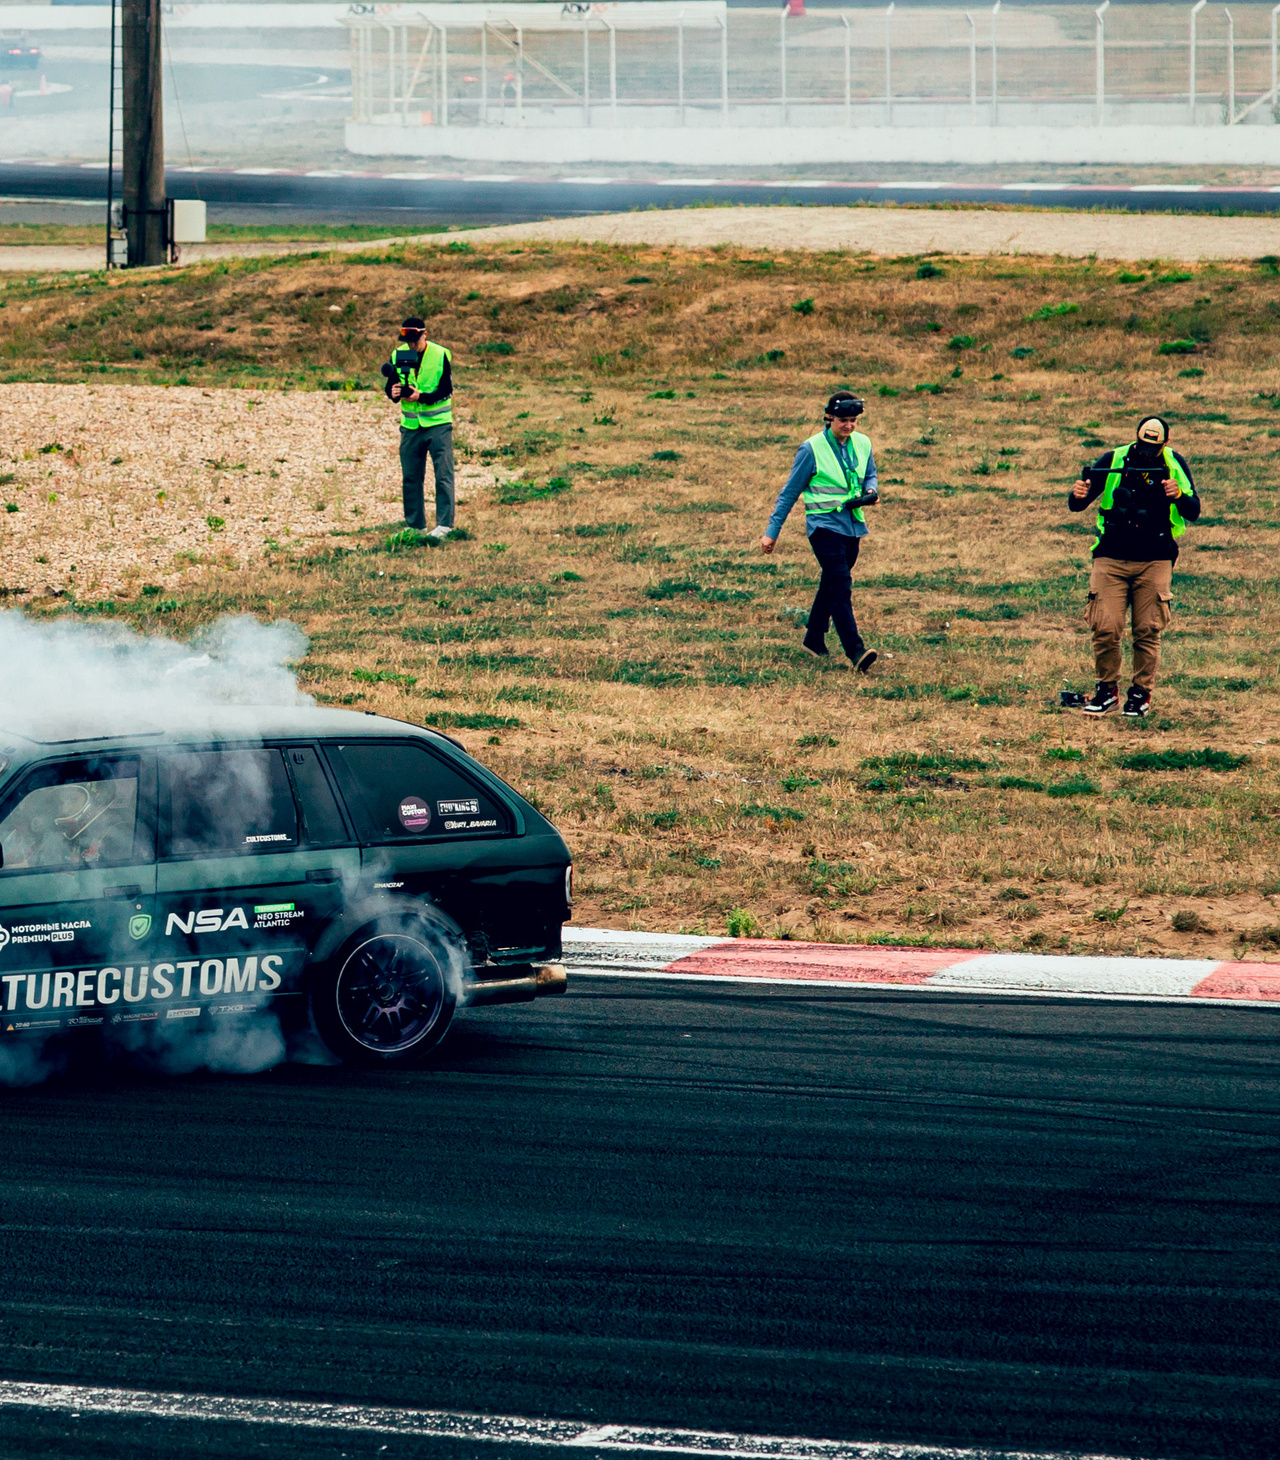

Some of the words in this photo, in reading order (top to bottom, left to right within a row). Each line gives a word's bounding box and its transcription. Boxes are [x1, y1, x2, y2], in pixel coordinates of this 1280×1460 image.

[165, 907, 249, 936] NSA
[257, 913, 273, 921] NEO
[275, 911, 304, 920] STREAM
[11, 923, 60, 934] МОТОРНЫЕ
[61, 920, 92, 930] МАСЛА
[253, 919, 290, 928] ATLANTIC
[12, 934, 51, 944] PREMIUM
[52, 932, 74, 941] PLUS
[219, 1004, 244, 1012] TXG
